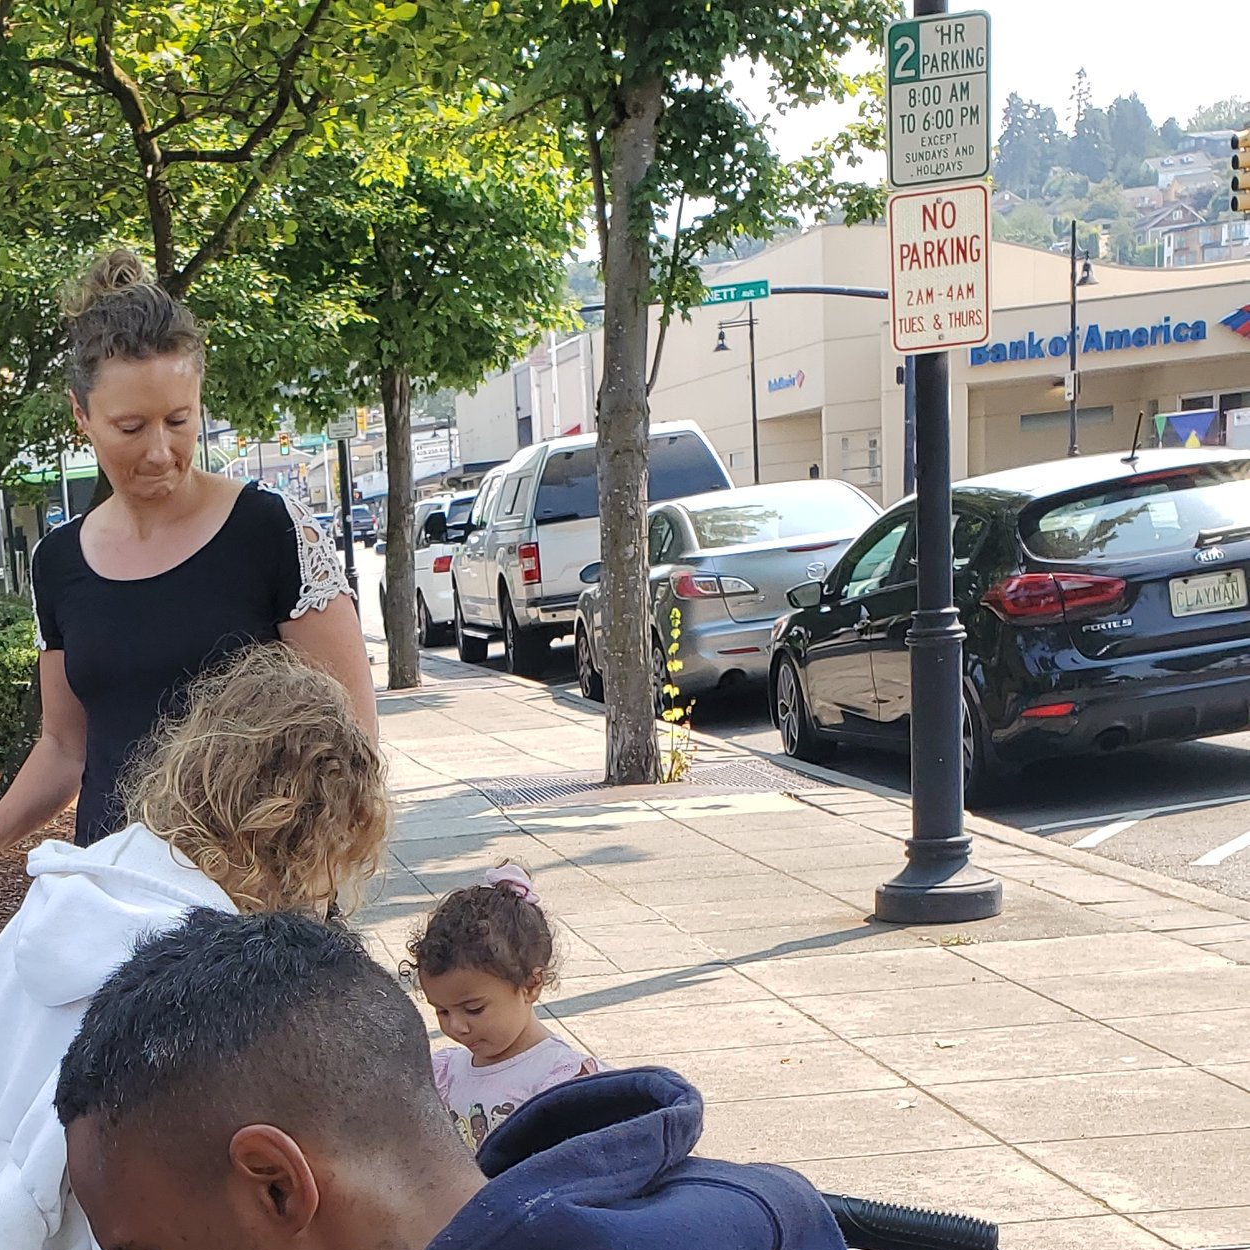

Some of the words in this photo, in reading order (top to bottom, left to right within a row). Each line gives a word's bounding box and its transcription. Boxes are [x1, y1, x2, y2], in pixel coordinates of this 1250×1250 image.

[939, 23, 966, 46] HR
[894, 36, 916, 78] 2
[922, 47, 985, 74] PARKING
[908, 85, 942, 108] 8:00
[950, 81, 970, 103] AM
[899, 113, 916, 134] TO
[922, 109, 954, 132] 6:00
[960, 105, 980, 127] PM
[920, 133, 958, 148] EXCEPT
[905, 148, 949, 164] SUNDAYS
[954, 145, 975, 158] AND
[916, 161, 963, 177] HOLIDAYS
[922, 201, 957, 232] NO
[899, 235, 981, 272] PARKING
[933, 314, 943, 330] &
[1083, 316, 1207, 354] America
[1176, 583, 1240, 608] CLAYMAN
